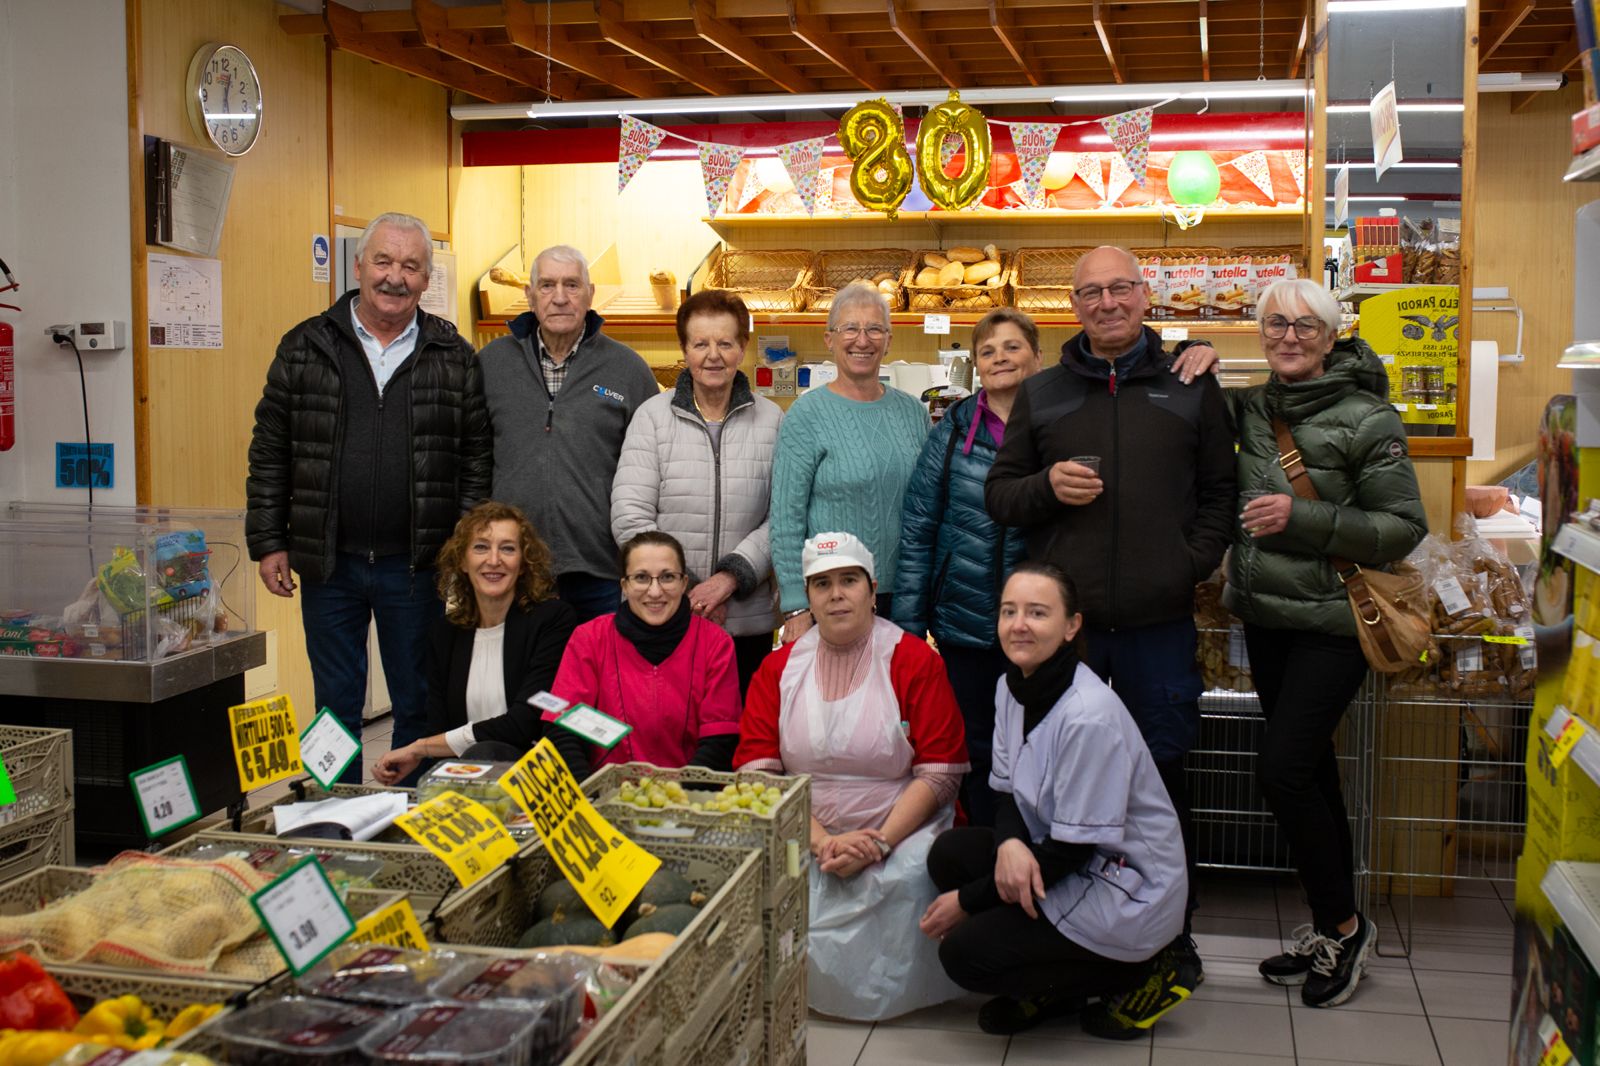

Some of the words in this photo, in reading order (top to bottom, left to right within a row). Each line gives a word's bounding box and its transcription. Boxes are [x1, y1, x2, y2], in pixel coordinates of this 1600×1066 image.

[212, 60, 219, 73] 11
[221, 59, 230, 72] 12
[233, 67, 238, 79] 1
[239, 81, 246, 94] 2
[202, 89, 208, 102] 9
[241, 100, 248, 113] 3
[213, 124, 219, 137] 7
[221, 130, 229, 143] 6
[1117, 122, 1141, 138] BUON
[627, 129, 650, 147] BUON
[1022, 134, 1046, 146] BUON
[708, 154, 731, 167] BUON
[790, 151, 813, 165] BUON
[1164, 266, 1205, 279] nutella
[60, 458, 110, 487] 50%
[817, 541, 838, 553] coop
[269, 713, 285, 740] 500
[509, 745, 569, 812] ZUCCA
[533, 780, 581, 837] DELICA
[599, 886, 617, 907] 92
